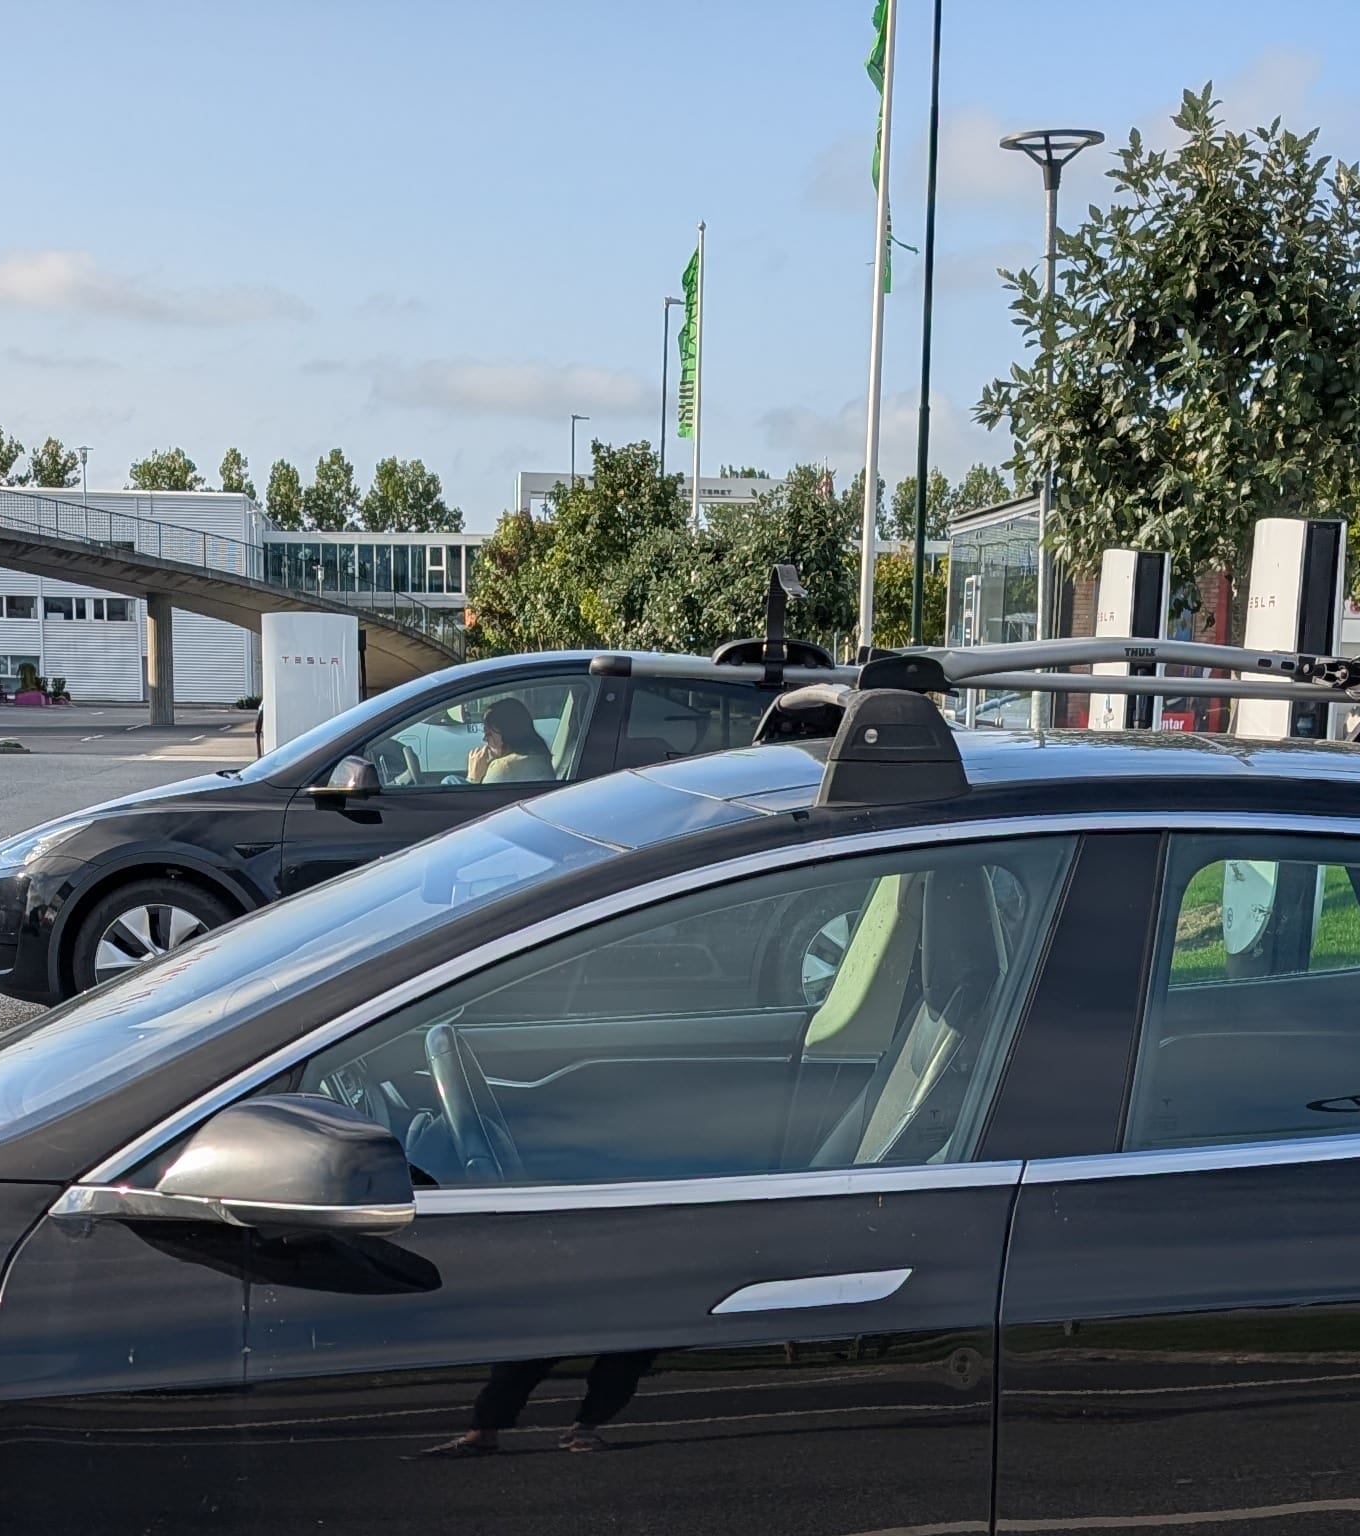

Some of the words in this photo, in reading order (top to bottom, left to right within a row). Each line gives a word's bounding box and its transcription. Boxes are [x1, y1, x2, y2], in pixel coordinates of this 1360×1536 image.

[1249, 595, 1276, 609] ESLA
[1124, 647, 1159, 657] THULE
[281, 656, 339, 665] TESLA
